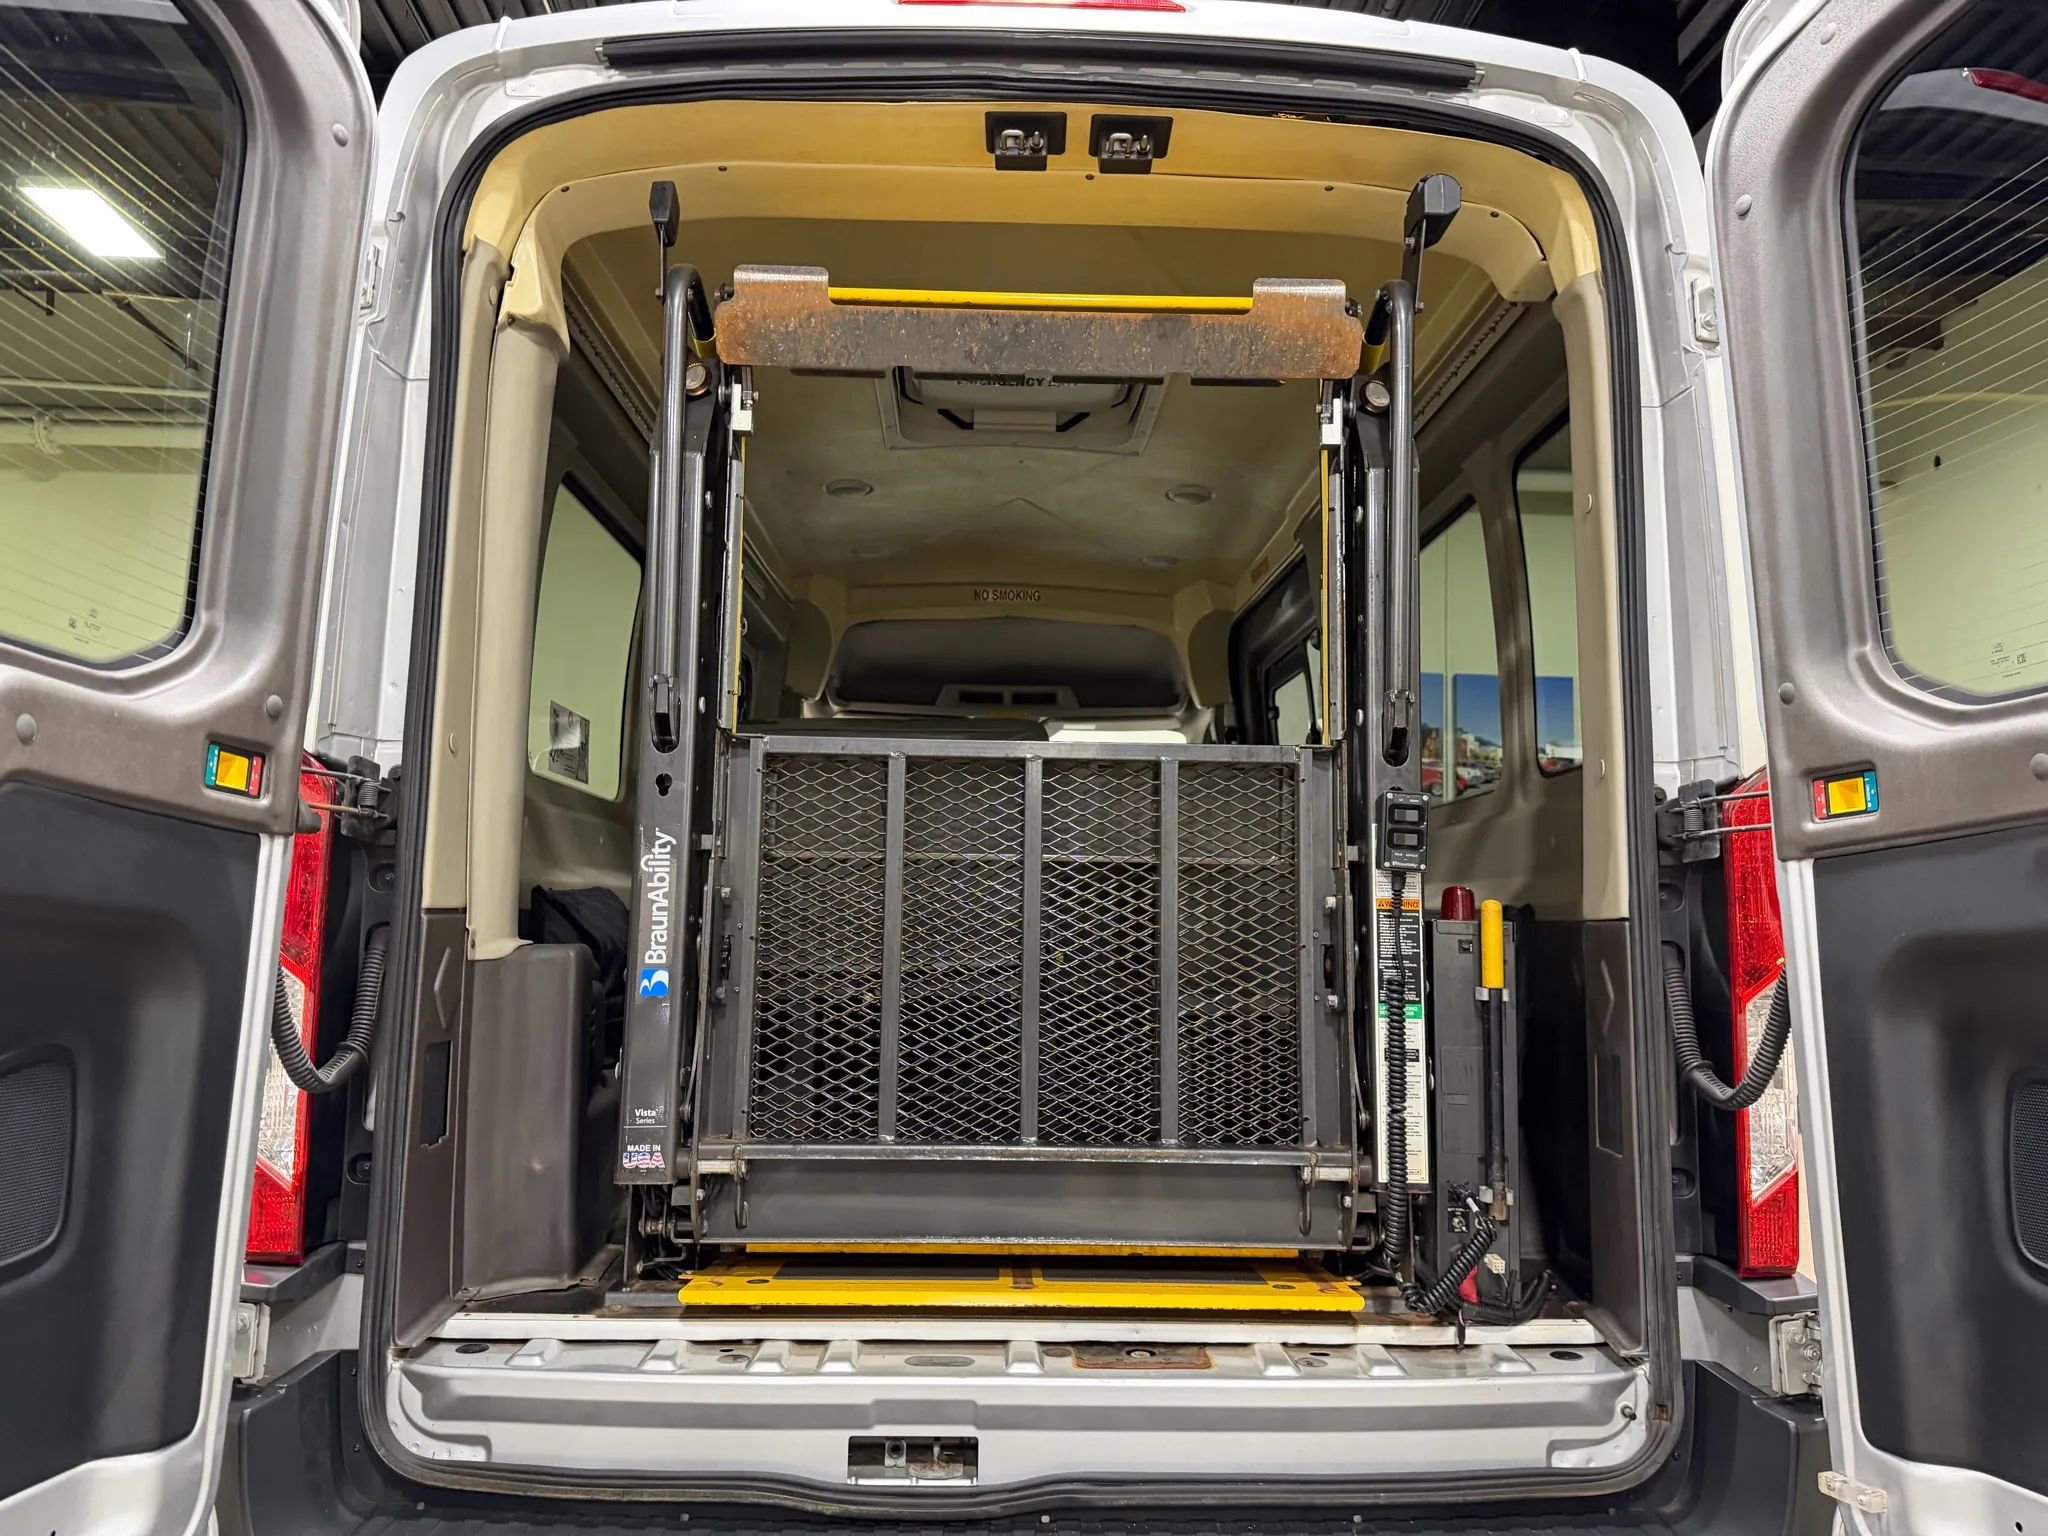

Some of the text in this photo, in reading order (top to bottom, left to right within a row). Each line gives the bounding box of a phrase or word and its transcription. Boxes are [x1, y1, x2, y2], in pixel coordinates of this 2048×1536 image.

[974, 589, 1041, 602] NO SMOKING
[640, 828, 677, 964] BraunAbility
[634, 1108, 656, 1117] Vista
[627, 1144, 661, 1152] MADE IN
[622, 1152, 666, 1168] USA
